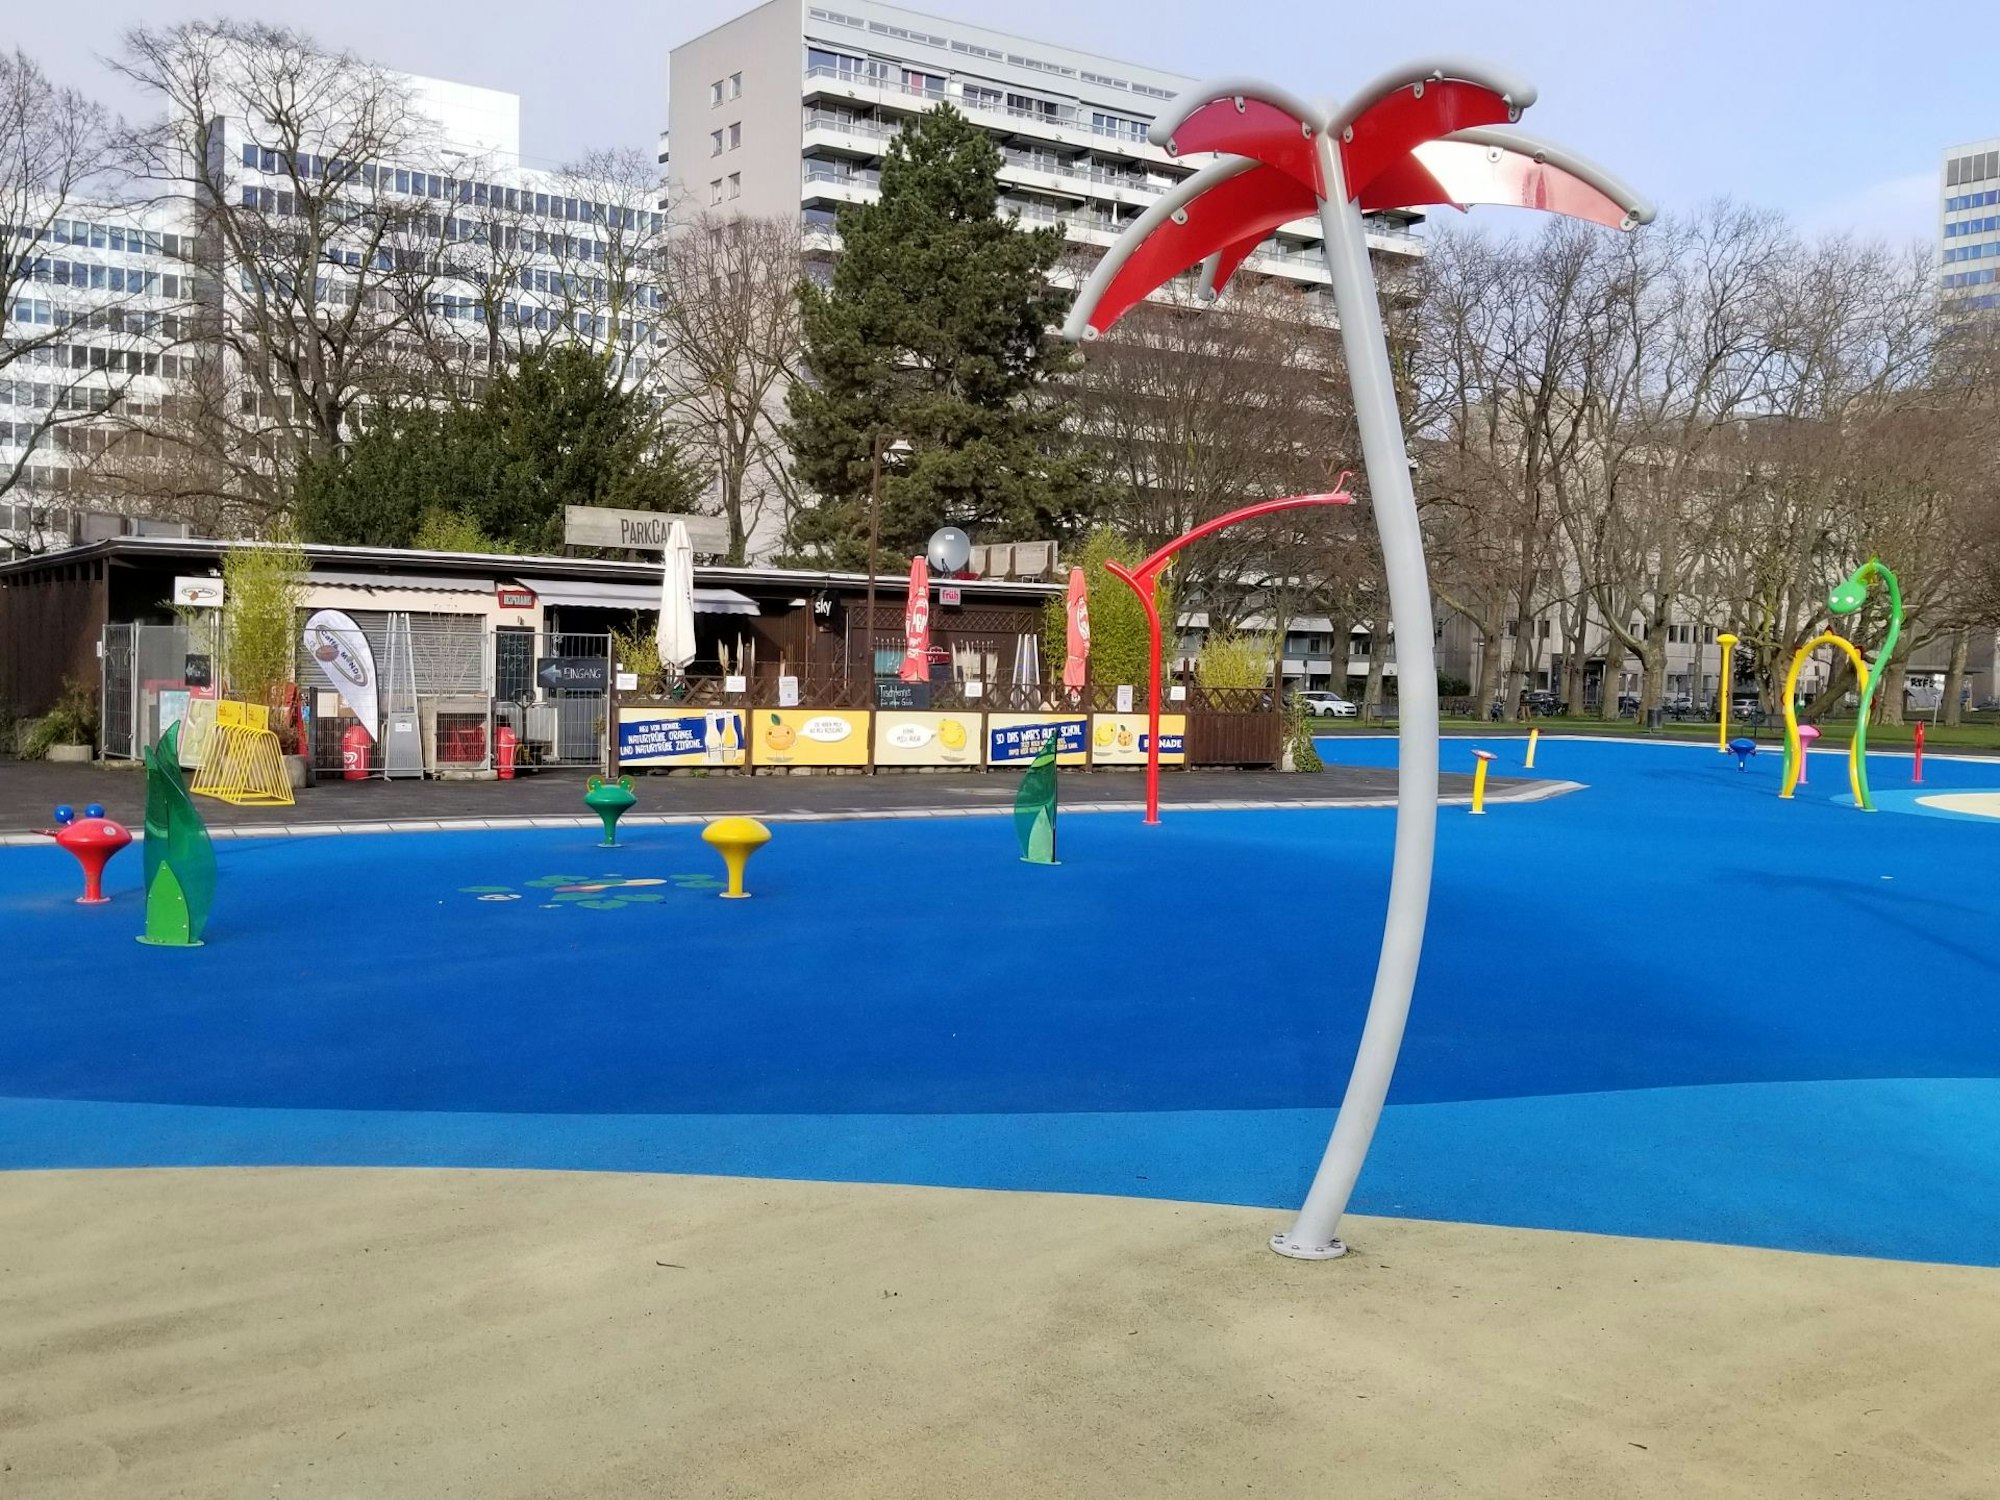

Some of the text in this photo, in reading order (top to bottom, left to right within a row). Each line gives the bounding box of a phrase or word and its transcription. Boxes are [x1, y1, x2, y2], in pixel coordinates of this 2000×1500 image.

[815, 597, 832, 617] sky
[563, 667, 602, 679] EINGANG
[996, 733, 1005, 745] SO
[1007, 731, 1020, 743] DAS
[1143, 738, 1182, 749] BNADE
[620, 745, 634, 756] UND
